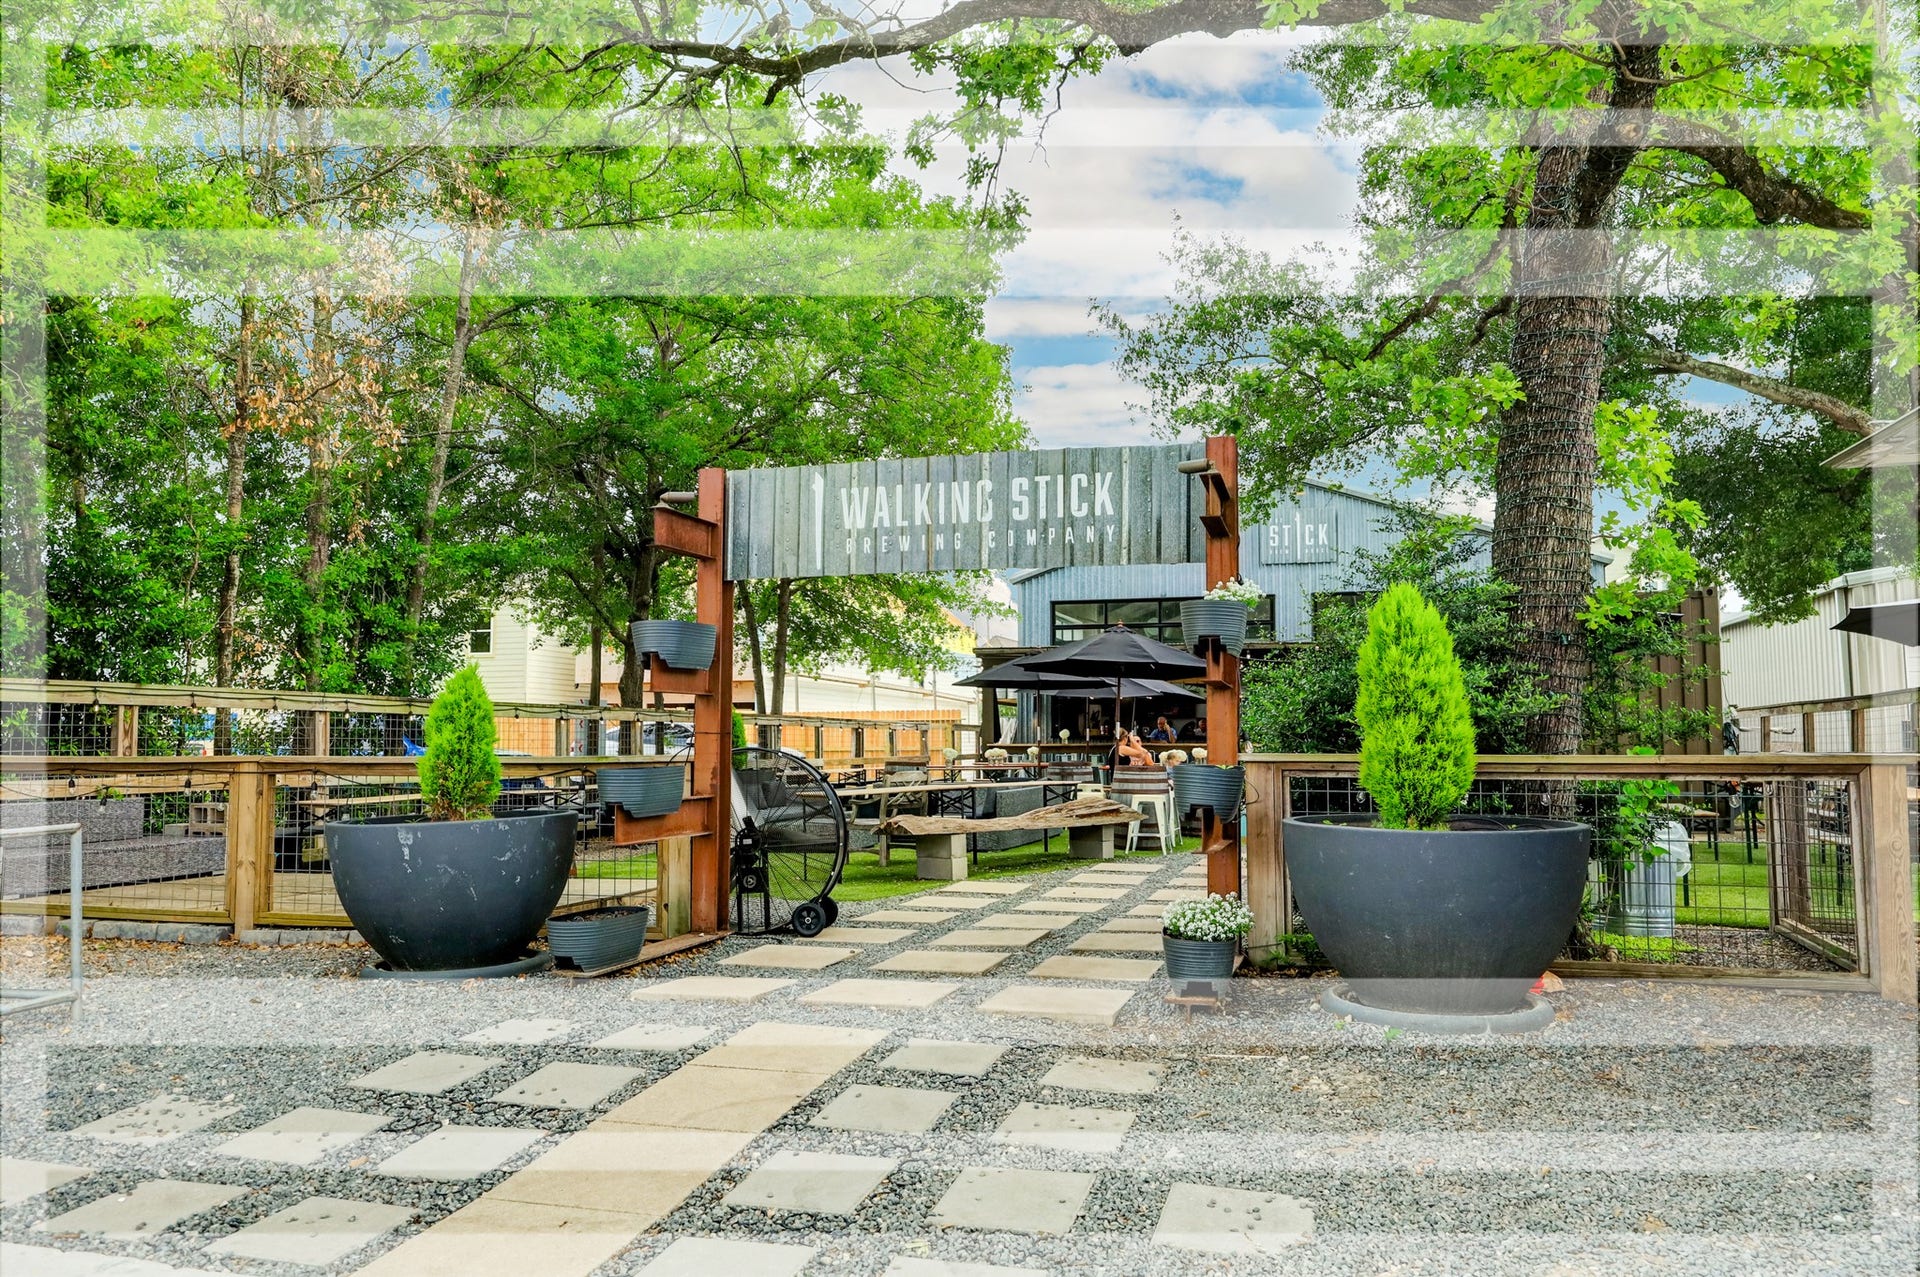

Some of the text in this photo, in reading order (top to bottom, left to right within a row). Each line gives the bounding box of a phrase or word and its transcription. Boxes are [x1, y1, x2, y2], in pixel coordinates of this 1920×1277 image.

[840, 471, 1115, 530] WALKING STICK
[846, 524, 1116, 554] BREWING COMPANY
